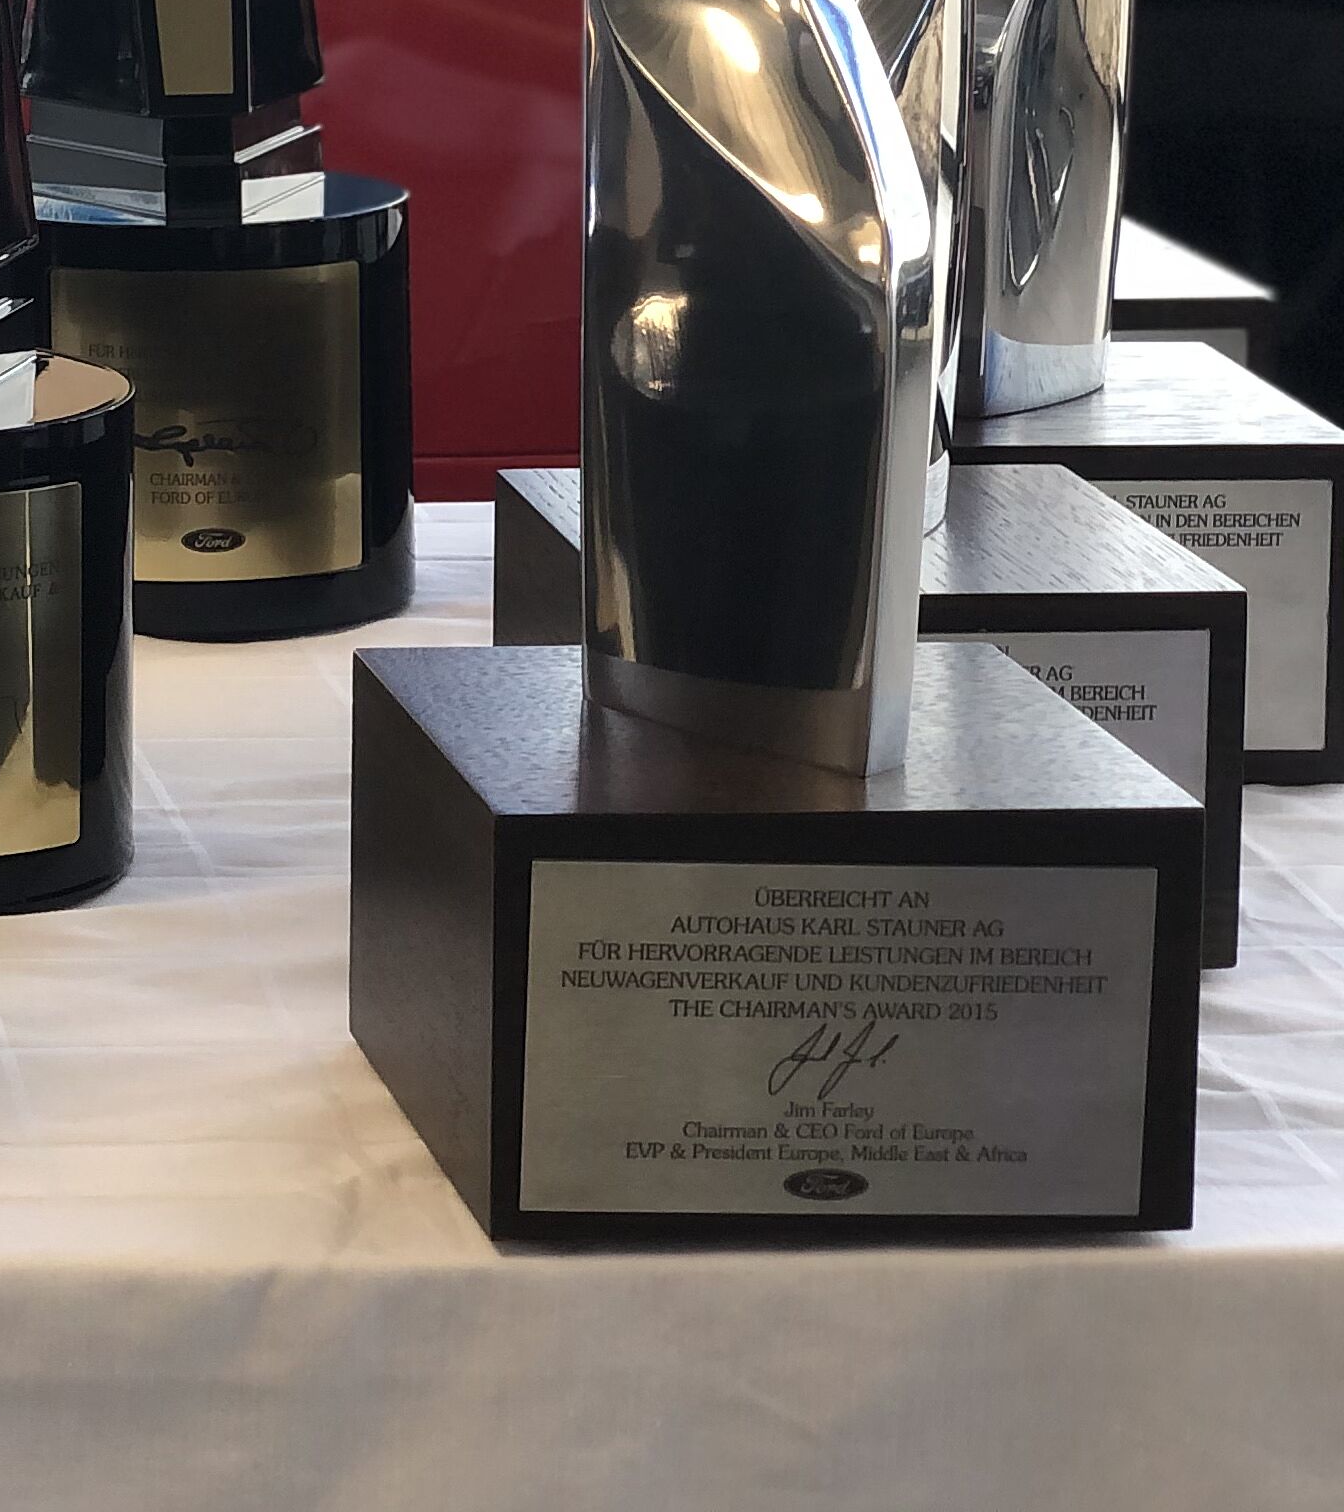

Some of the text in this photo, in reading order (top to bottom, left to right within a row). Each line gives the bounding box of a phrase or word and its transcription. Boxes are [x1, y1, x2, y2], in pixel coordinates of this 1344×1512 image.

[150, 473, 225, 486] CHAIRMAN
[151, 491, 191, 505] FORD
[194, 491, 214, 504] OF
[1126, 494, 1198, 509] STAUNER
[1202, 494, 1226, 509] AG
[1156, 514, 1171, 528] IN
[1175, 513, 1208, 528] DEN
[1212, 512, 1301, 528] BEREICHEN
[1045, 665, 1073, 681] AG
[1070, 684, 1145, 701] BEREICH
[755, 886, 930, 908] ÜBERREICHT AN
[671, 916, 1005, 937] AUTOHAUS KARL STAUNER AG
[578, 939, 1092, 966] FÜR HERVORRAGENDE LEISTUNGEN IM BEREICH
[561, 970, 1108, 994] NEUWAGENVERKAUF UND KUNDENZUFRIEDENHEIT
[669, 999, 999, 1021] THE CHAIRMAN'S AWARD 2015
[784, 1101, 875, 1122] Jim Farley
[682, 1121, 974, 1144] Chairman & CEO Ford of Europe
[626, 1141, 1028, 1163] EVP & President Europe, Middle East & Africa
